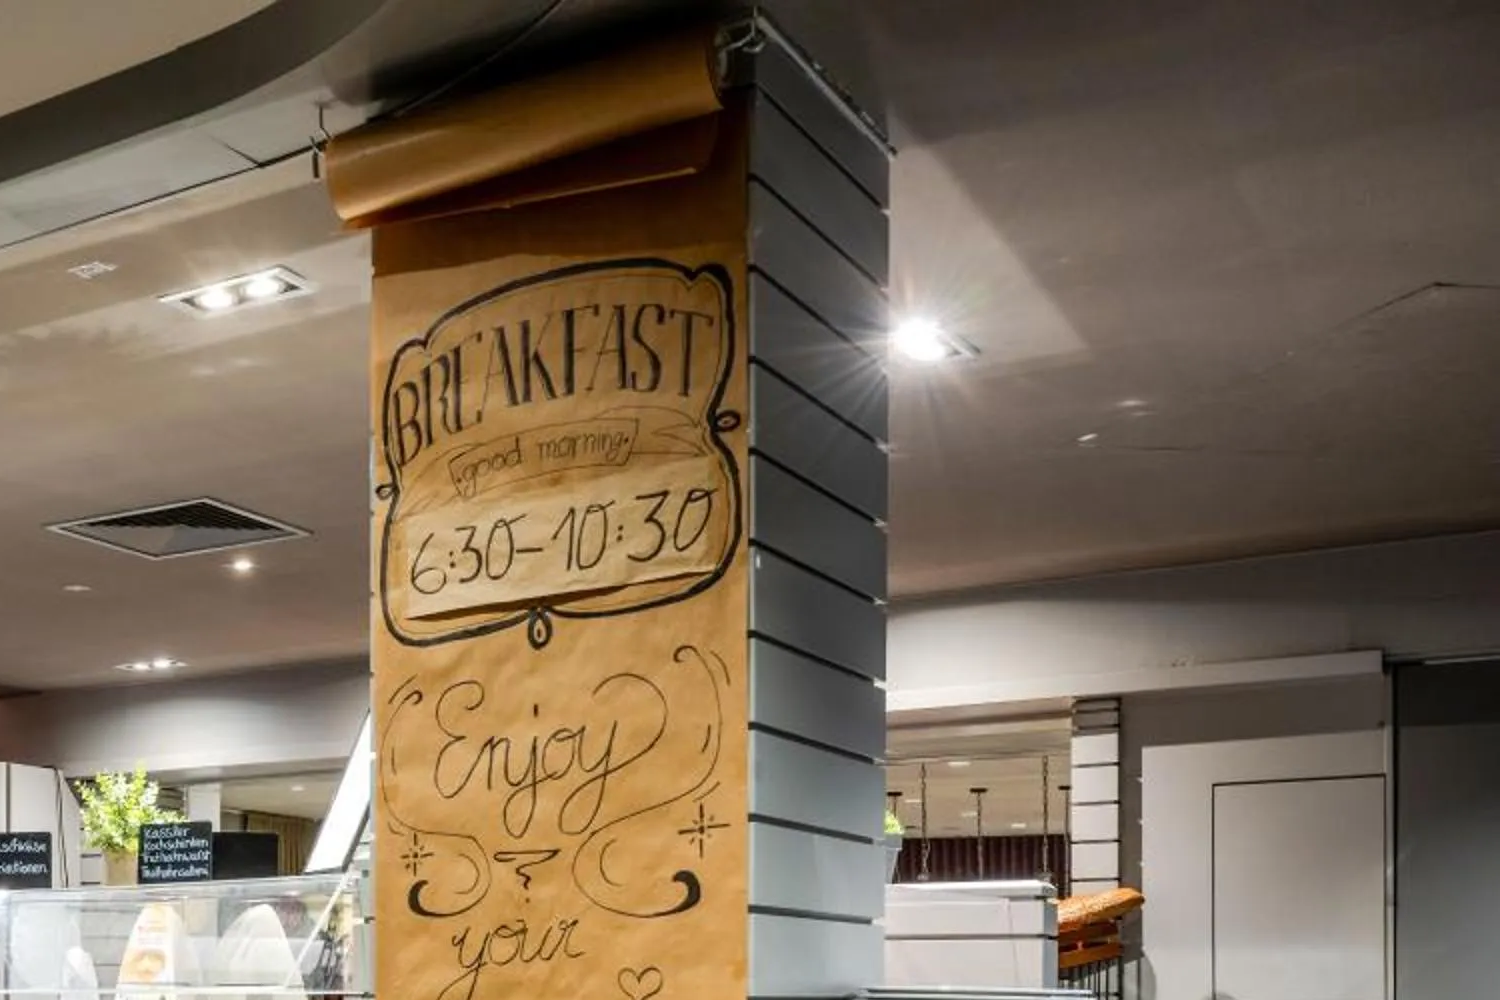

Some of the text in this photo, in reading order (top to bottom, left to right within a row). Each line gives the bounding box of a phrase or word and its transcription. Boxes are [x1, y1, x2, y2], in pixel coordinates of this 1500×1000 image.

[392, 302, 714, 468] BREAKFAST
[462, 428, 624, 490] good morning
[433, 678, 666, 839] Enjoy
